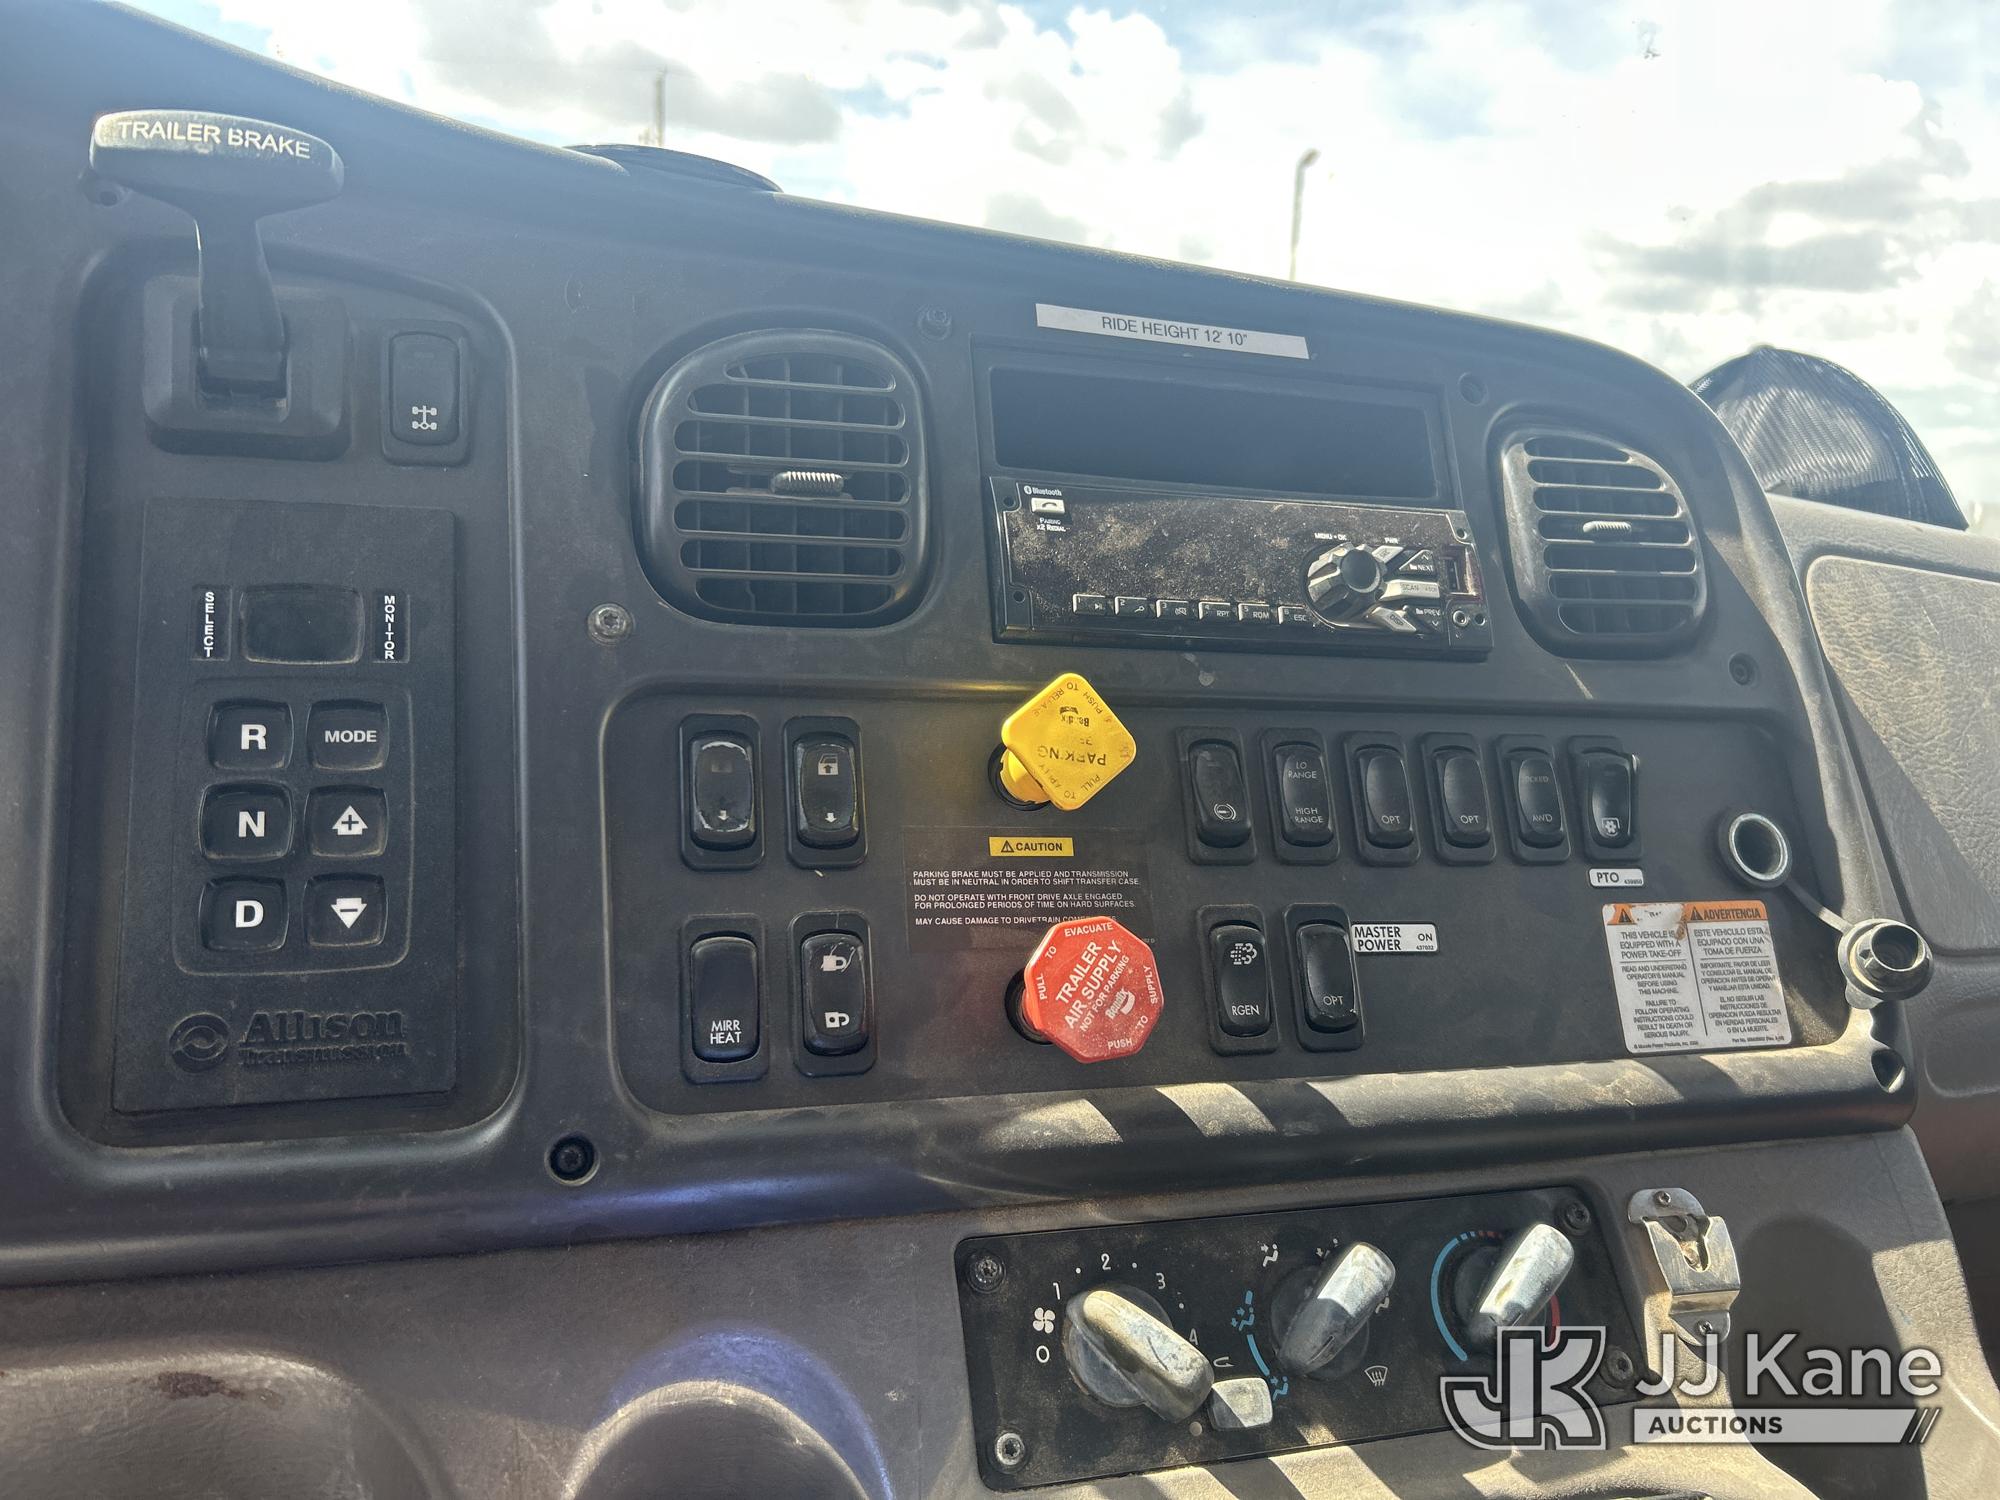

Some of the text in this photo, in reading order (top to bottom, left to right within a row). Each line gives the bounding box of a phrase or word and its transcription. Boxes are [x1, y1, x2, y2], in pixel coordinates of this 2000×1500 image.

[119, 121, 310, 159] TRAILER BRAKE
[1102, 316, 1248, 346] RIDE HEIGHT 12' 10"
[1417, 564, 1434, 572] NEXT
[1423, 608, 1441, 616] PREV
[204, 592, 215, 658] SELECT
[384, 595, 395, 660] MONITOR
[1066, 682, 1102, 715] PUSH TO
[240, 723, 268, 750] R
[325, 730, 377, 743] MODE
[1038, 745, 1106, 766] PARKNG
[1288, 771, 1317, 779] RANGE
[1063, 775, 1101, 800] PULL TO
[1381, 815, 1400, 824] OPT
[1460, 815, 1479, 824] OPT
[1532, 814, 1553, 822] AWD
[238, 811, 265, 838] N
[1015, 842, 1062, 851] CAUTION
[1019, 870, 1052, 878] APPLIED
[1053, 870, 1070, 878] AND
[1071, 870, 1129, 878] TRANSMISSION
[1596, 871, 1619, 883] PTO
[987, 893, 1007, 901] WITH
[1009, 893, 1035, 901] FRONT
[987, 901, 1022, 909] PERIODS
[1094, 900, 1136, 908] SURFACES.
[235, 900, 264, 929] D
[1703, 908, 1761, 920] ADVERTENCIA
[934, 917, 963, 925] CAUSE
[965, 917, 999, 925] DAMAGE
[1014, 916, 1061, 924] DRIVETRAIN
[1354, 926, 1401, 938] MASTER
[1417, 933, 1433, 941] ON
[1621, 930, 1675, 939] THIS VEHICLE IS
[1694, 927, 1764, 937] ESTE VEHICULO ESTA
[1357, 939, 1401, 951] POWER
[1620, 939, 1681, 949] EQUIPPED WITH A
[1697, 936, 1764, 946] EQUIPADO CON UNA
[1621, 949, 1681, 959] POWER TAKE-OFF
[1703, 946, 1762, 956] TOMA DE FUERZA
[1036, 922, 1114, 1000] PULL TO EVACUATE
[1055, 941, 1102, 1004] TRAILER
[1064, 999, 1088, 1029] AIR
[1081, 940, 1121, 1000] SUPPLY
[1079, 955, 1130, 1032] NOT FOR PARKING
[1323, 996, 1344, 1006] OPT
[1645, 999, 1667, 1007] FAILURE
[1107, 965, 1158, 1050] PUSH TO SUPPLY
[1231, 1005, 1260, 1016] RGEN
[1634, 1007, 1657, 1015] FOLLOW
[711, 1019, 741, 1032] MIRR
[710, 1031, 742, 1045] HEAT
[1101, 1253, 1112, 1270] 2
[1155, 1272, 1166, 1290] 3
[1052, 1282, 1061, 1300] 1
[1189, 1328, 1199, 1346] 4
